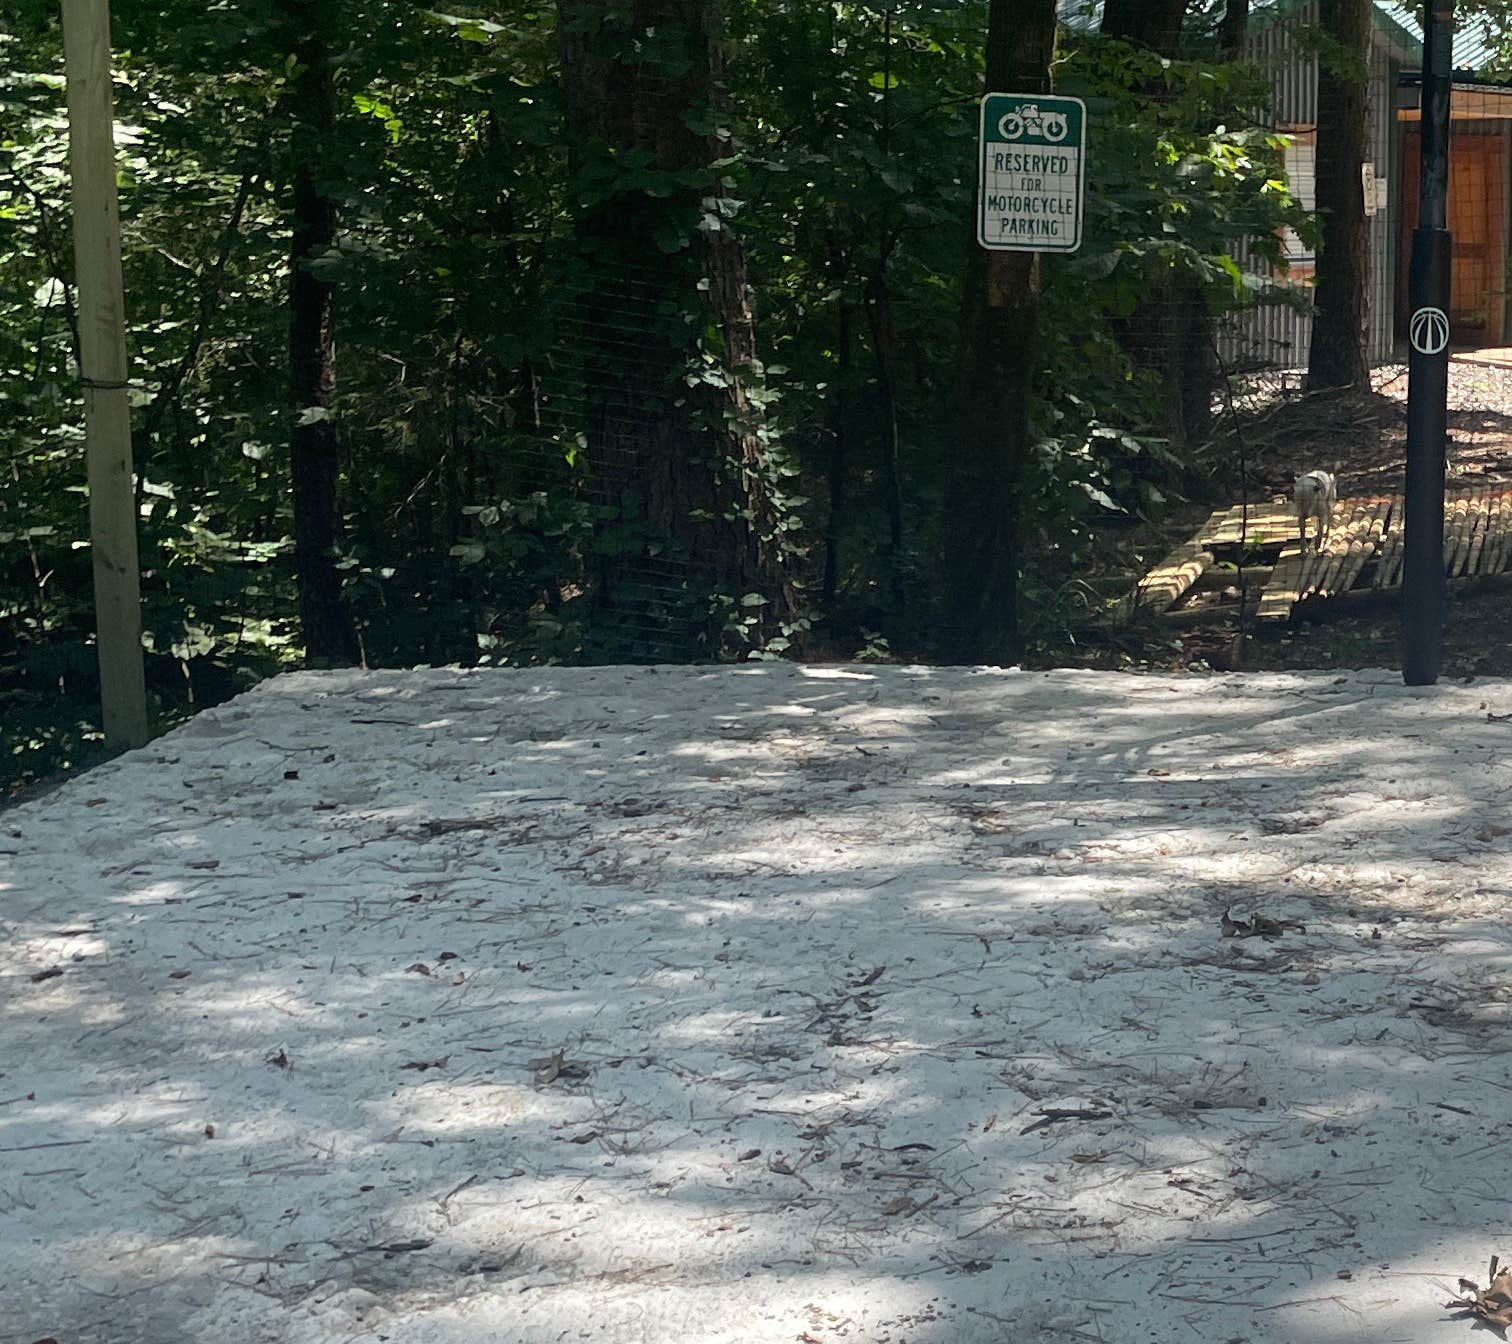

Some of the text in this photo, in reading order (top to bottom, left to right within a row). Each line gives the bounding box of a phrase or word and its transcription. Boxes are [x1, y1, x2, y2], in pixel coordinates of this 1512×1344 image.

[994, 152, 1068, 174] RESERVED
[1020, 177, 1042, 192] FOR
[987, 194, 1073, 215] MOTORCYCLE
[1001, 217, 1059, 236] PARKING
